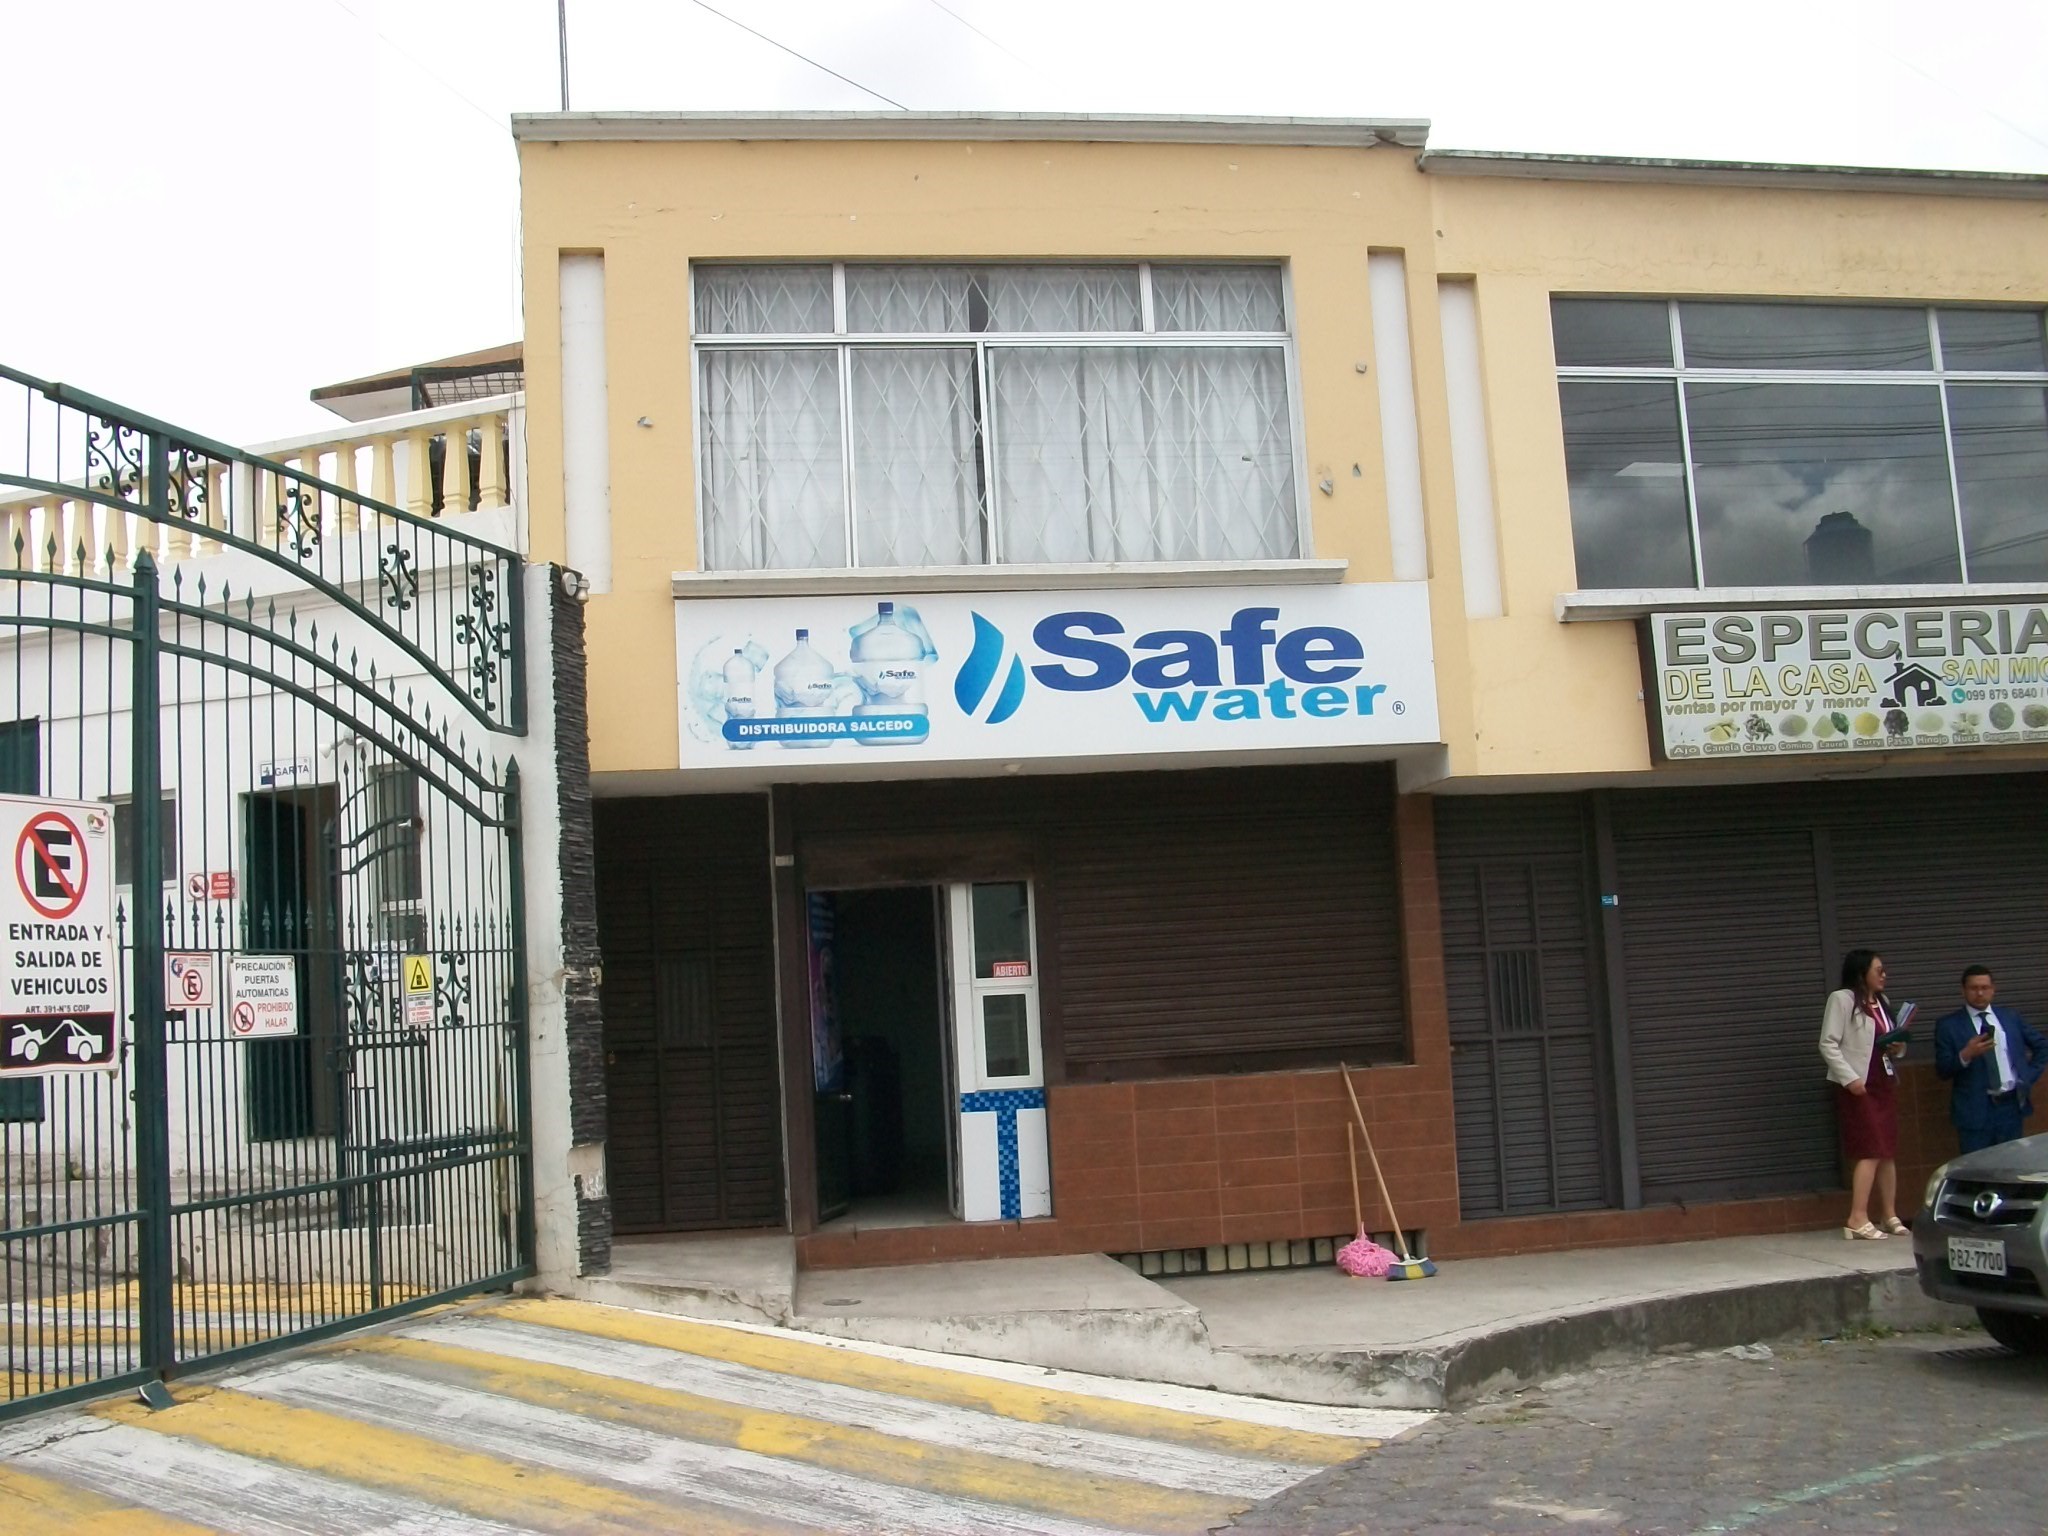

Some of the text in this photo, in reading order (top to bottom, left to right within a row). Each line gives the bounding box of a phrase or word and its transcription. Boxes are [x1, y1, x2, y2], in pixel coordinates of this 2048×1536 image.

[1664, 609, 2048, 666] ESPECERIA
[1030, 607, 1364, 692] Safe
[1942, 658, 1999, 687] SAN
[1664, 662, 1877, 701] DE LA CASA
[1133, 678, 1387, 722] water
[1966, 690, 1985, 701] 099
[1989, 688, 2008, 700] 879
[2012, 687, 2037, 699] 6840
[1665, 697, 1870, 716] ventas por mayor y menor
[739, 719, 913, 736] DISTRIBUIDORA SALCEDO
[1673, 747, 1697, 755] Ajo
[1704, 742, 1740, 753] Canela
[1744, 742, 1775, 753] Clavo
[1780, 741, 1813, 751] Comino
[1856, 736, 1881, 749] Curry
[1888, 735, 1912, 746] Pasas
[1917, 733, 1948, 747] Hinojo
[1953, 732, 1978, 744] Nuez
[274, 764, 309, 777] GARTA
[9, 923, 103, 941] ENTRADA Y
[15, 951, 102, 968] SALIDA DE
[995, 964, 1027, 977] ABIERTO
[11, 978, 108, 995] VEHICULOS
[244, 975, 280, 985] PUERTAS
[236, 988, 289, 998] AUTOMATICAS
[26, 1005, 42, 1014] ART.
[73, 1004, 91, 1012] COIP
[257, 1001, 294, 1012] PROHIBIDO
[265, 1017, 288, 1028] HALAR
